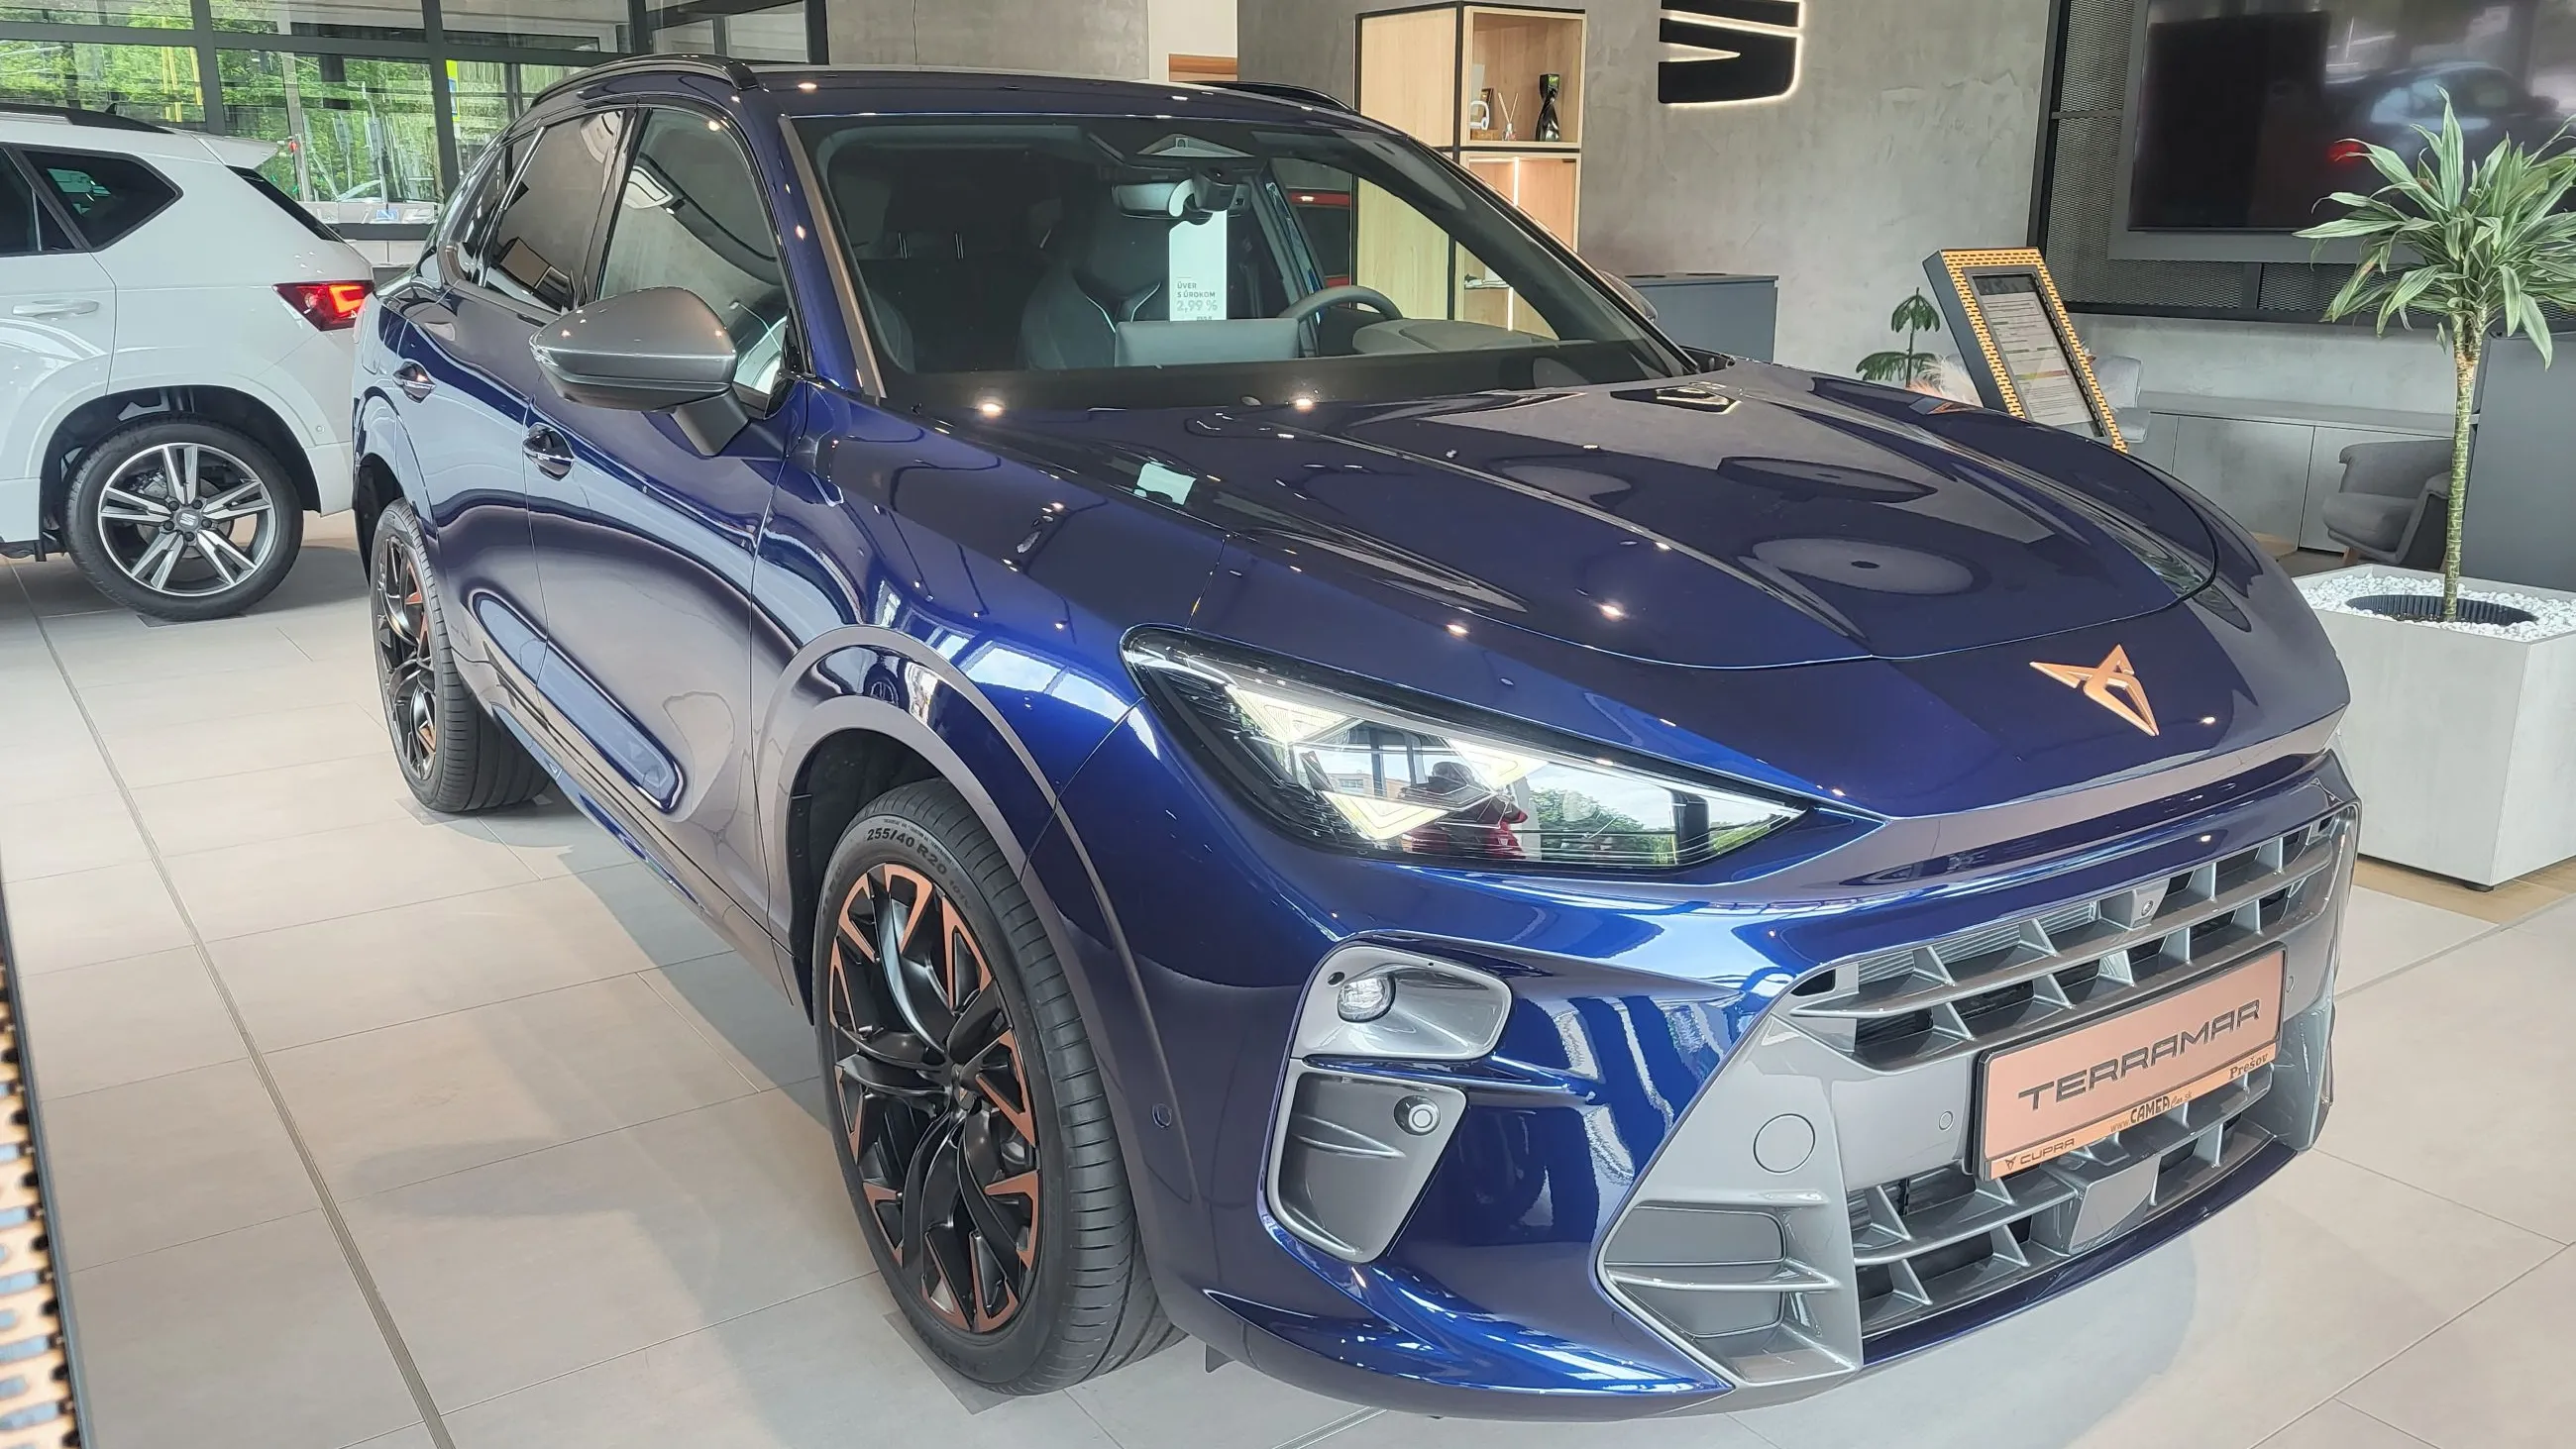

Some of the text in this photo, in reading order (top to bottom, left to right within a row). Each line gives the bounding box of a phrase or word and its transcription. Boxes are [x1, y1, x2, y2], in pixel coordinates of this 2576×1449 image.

[1177, 299, 1218, 313] 2,99 %
[867, 827, 915, 848] 255/40
[916, 843, 947, 876] R20
[2018, 998, 2261, 1111] TERRAMAR
[2228, 1053, 2269, 1080] Prešov
[2020, 1138, 2075, 1165] CUPRA
